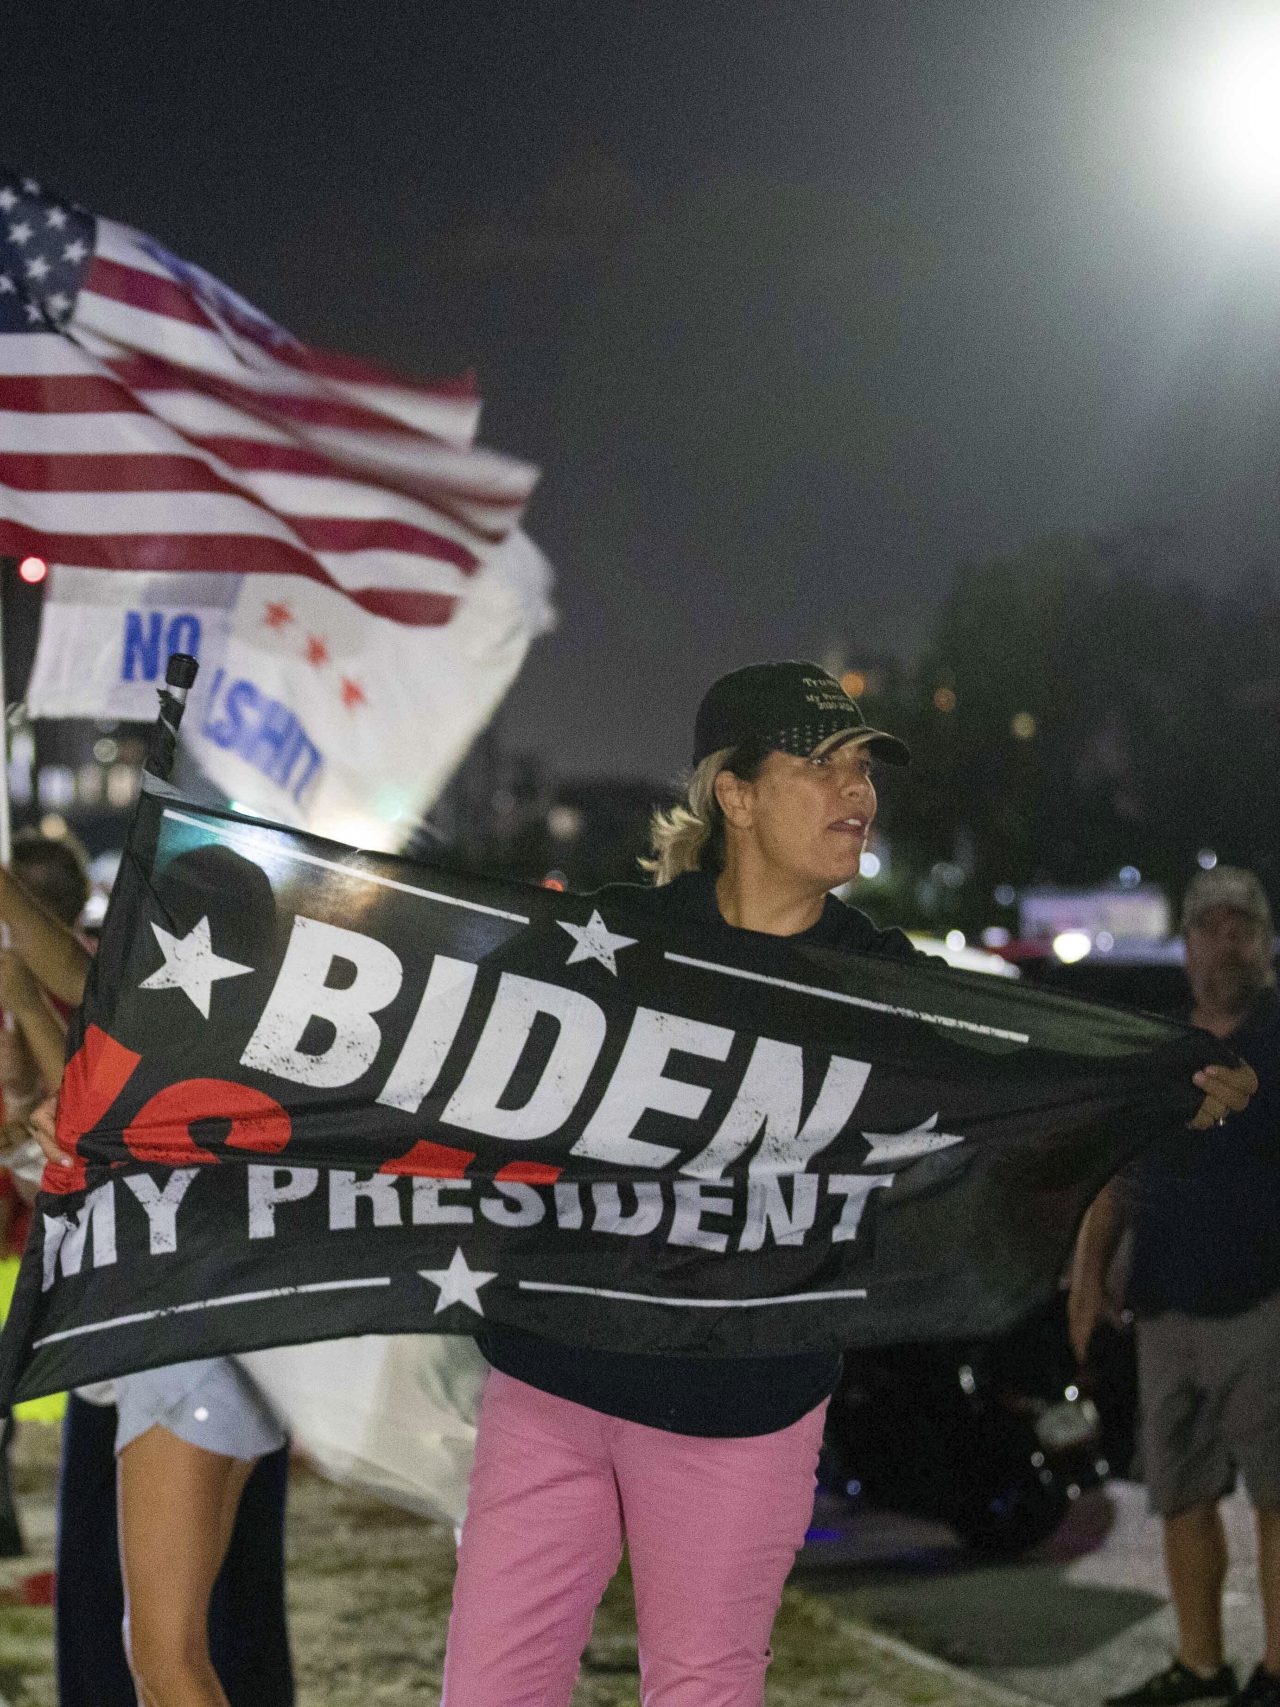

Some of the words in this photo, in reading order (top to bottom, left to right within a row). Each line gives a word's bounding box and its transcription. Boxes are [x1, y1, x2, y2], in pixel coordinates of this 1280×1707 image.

[122, 611, 202, 682] NO
[240, 915, 871, 1179] BIDEN
[41, 1168, 201, 1292] MY
[247, 1163, 895, 1253] PRESIDENT
